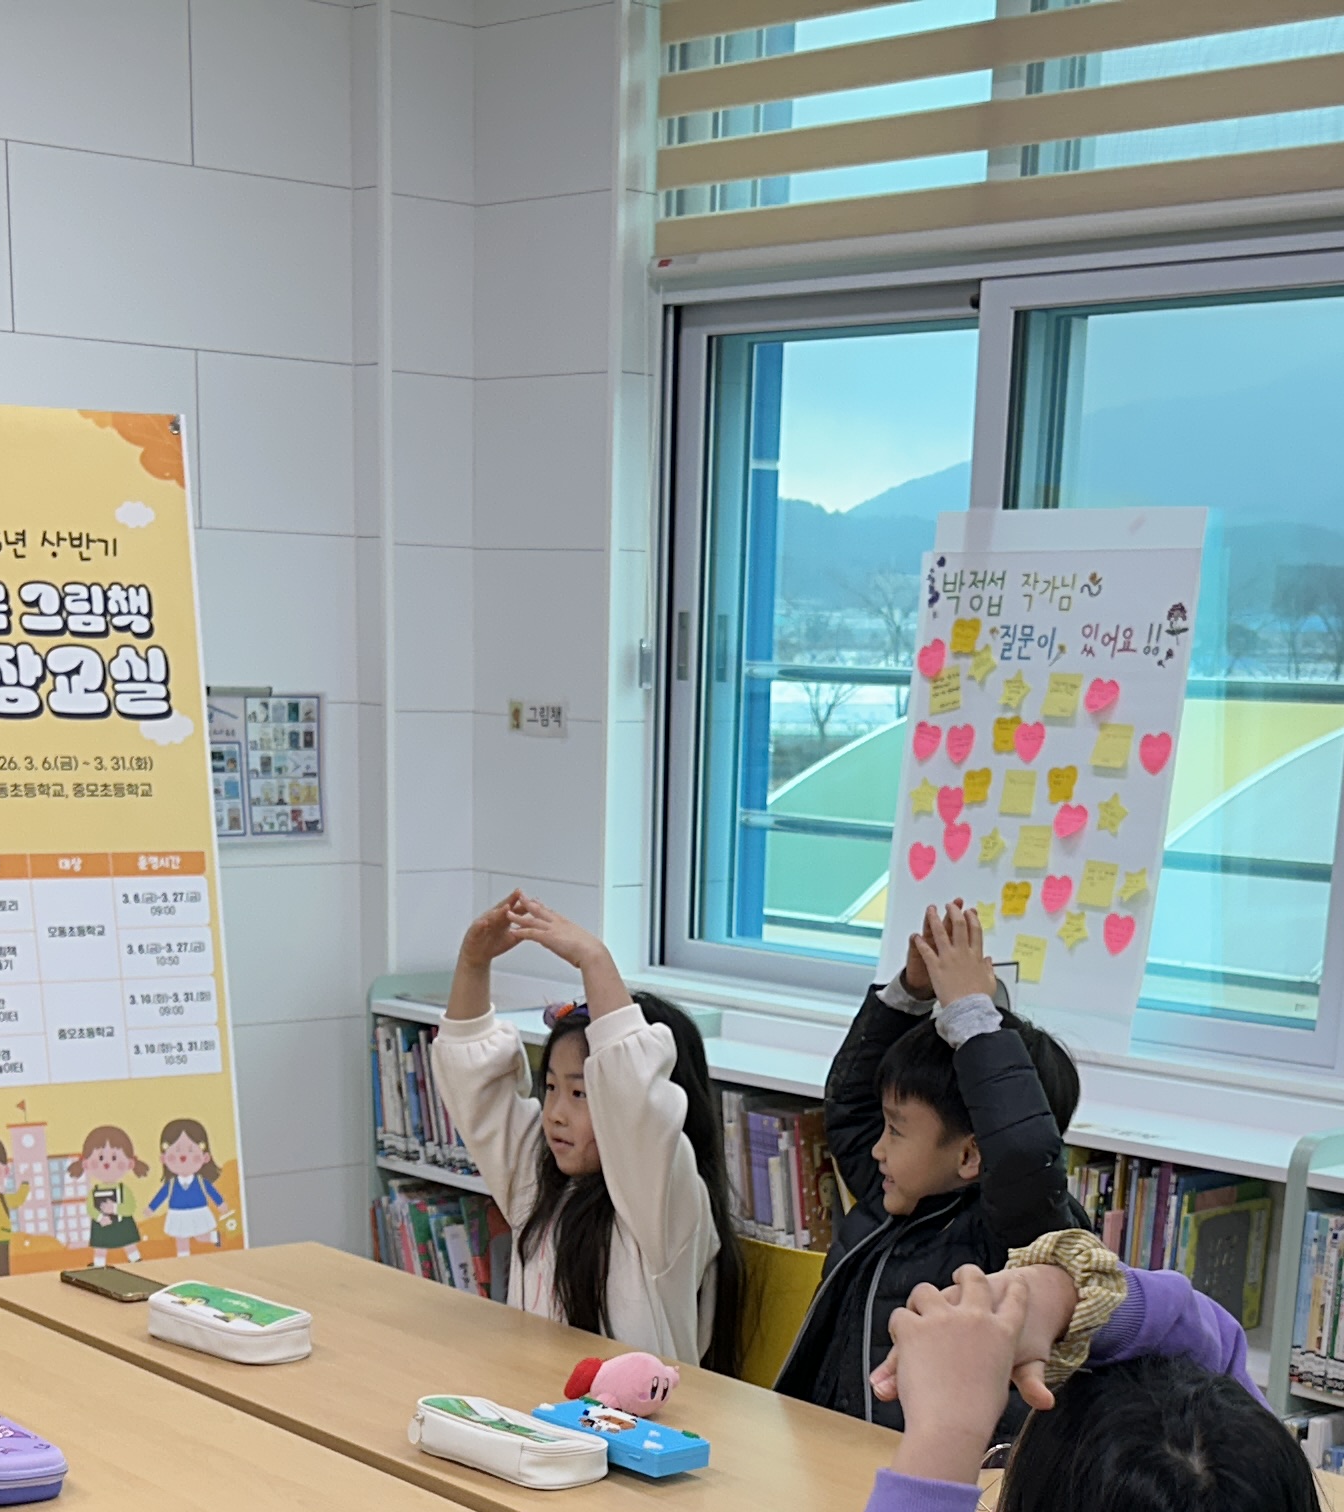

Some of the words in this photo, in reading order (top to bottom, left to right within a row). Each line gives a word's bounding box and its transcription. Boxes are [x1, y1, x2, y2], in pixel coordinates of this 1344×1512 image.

[40, 531, 118, 561] 상반기
[18, 581, 154, 638] 그림책
[942, 570, 1007, 617] 박정섭
[999, 624, 1057, 662] 질문이
[526, 706, 562, 728] 그림책
[58, 857, 82, 872] 대상
[137, 855, 181, 870] 운영시간
